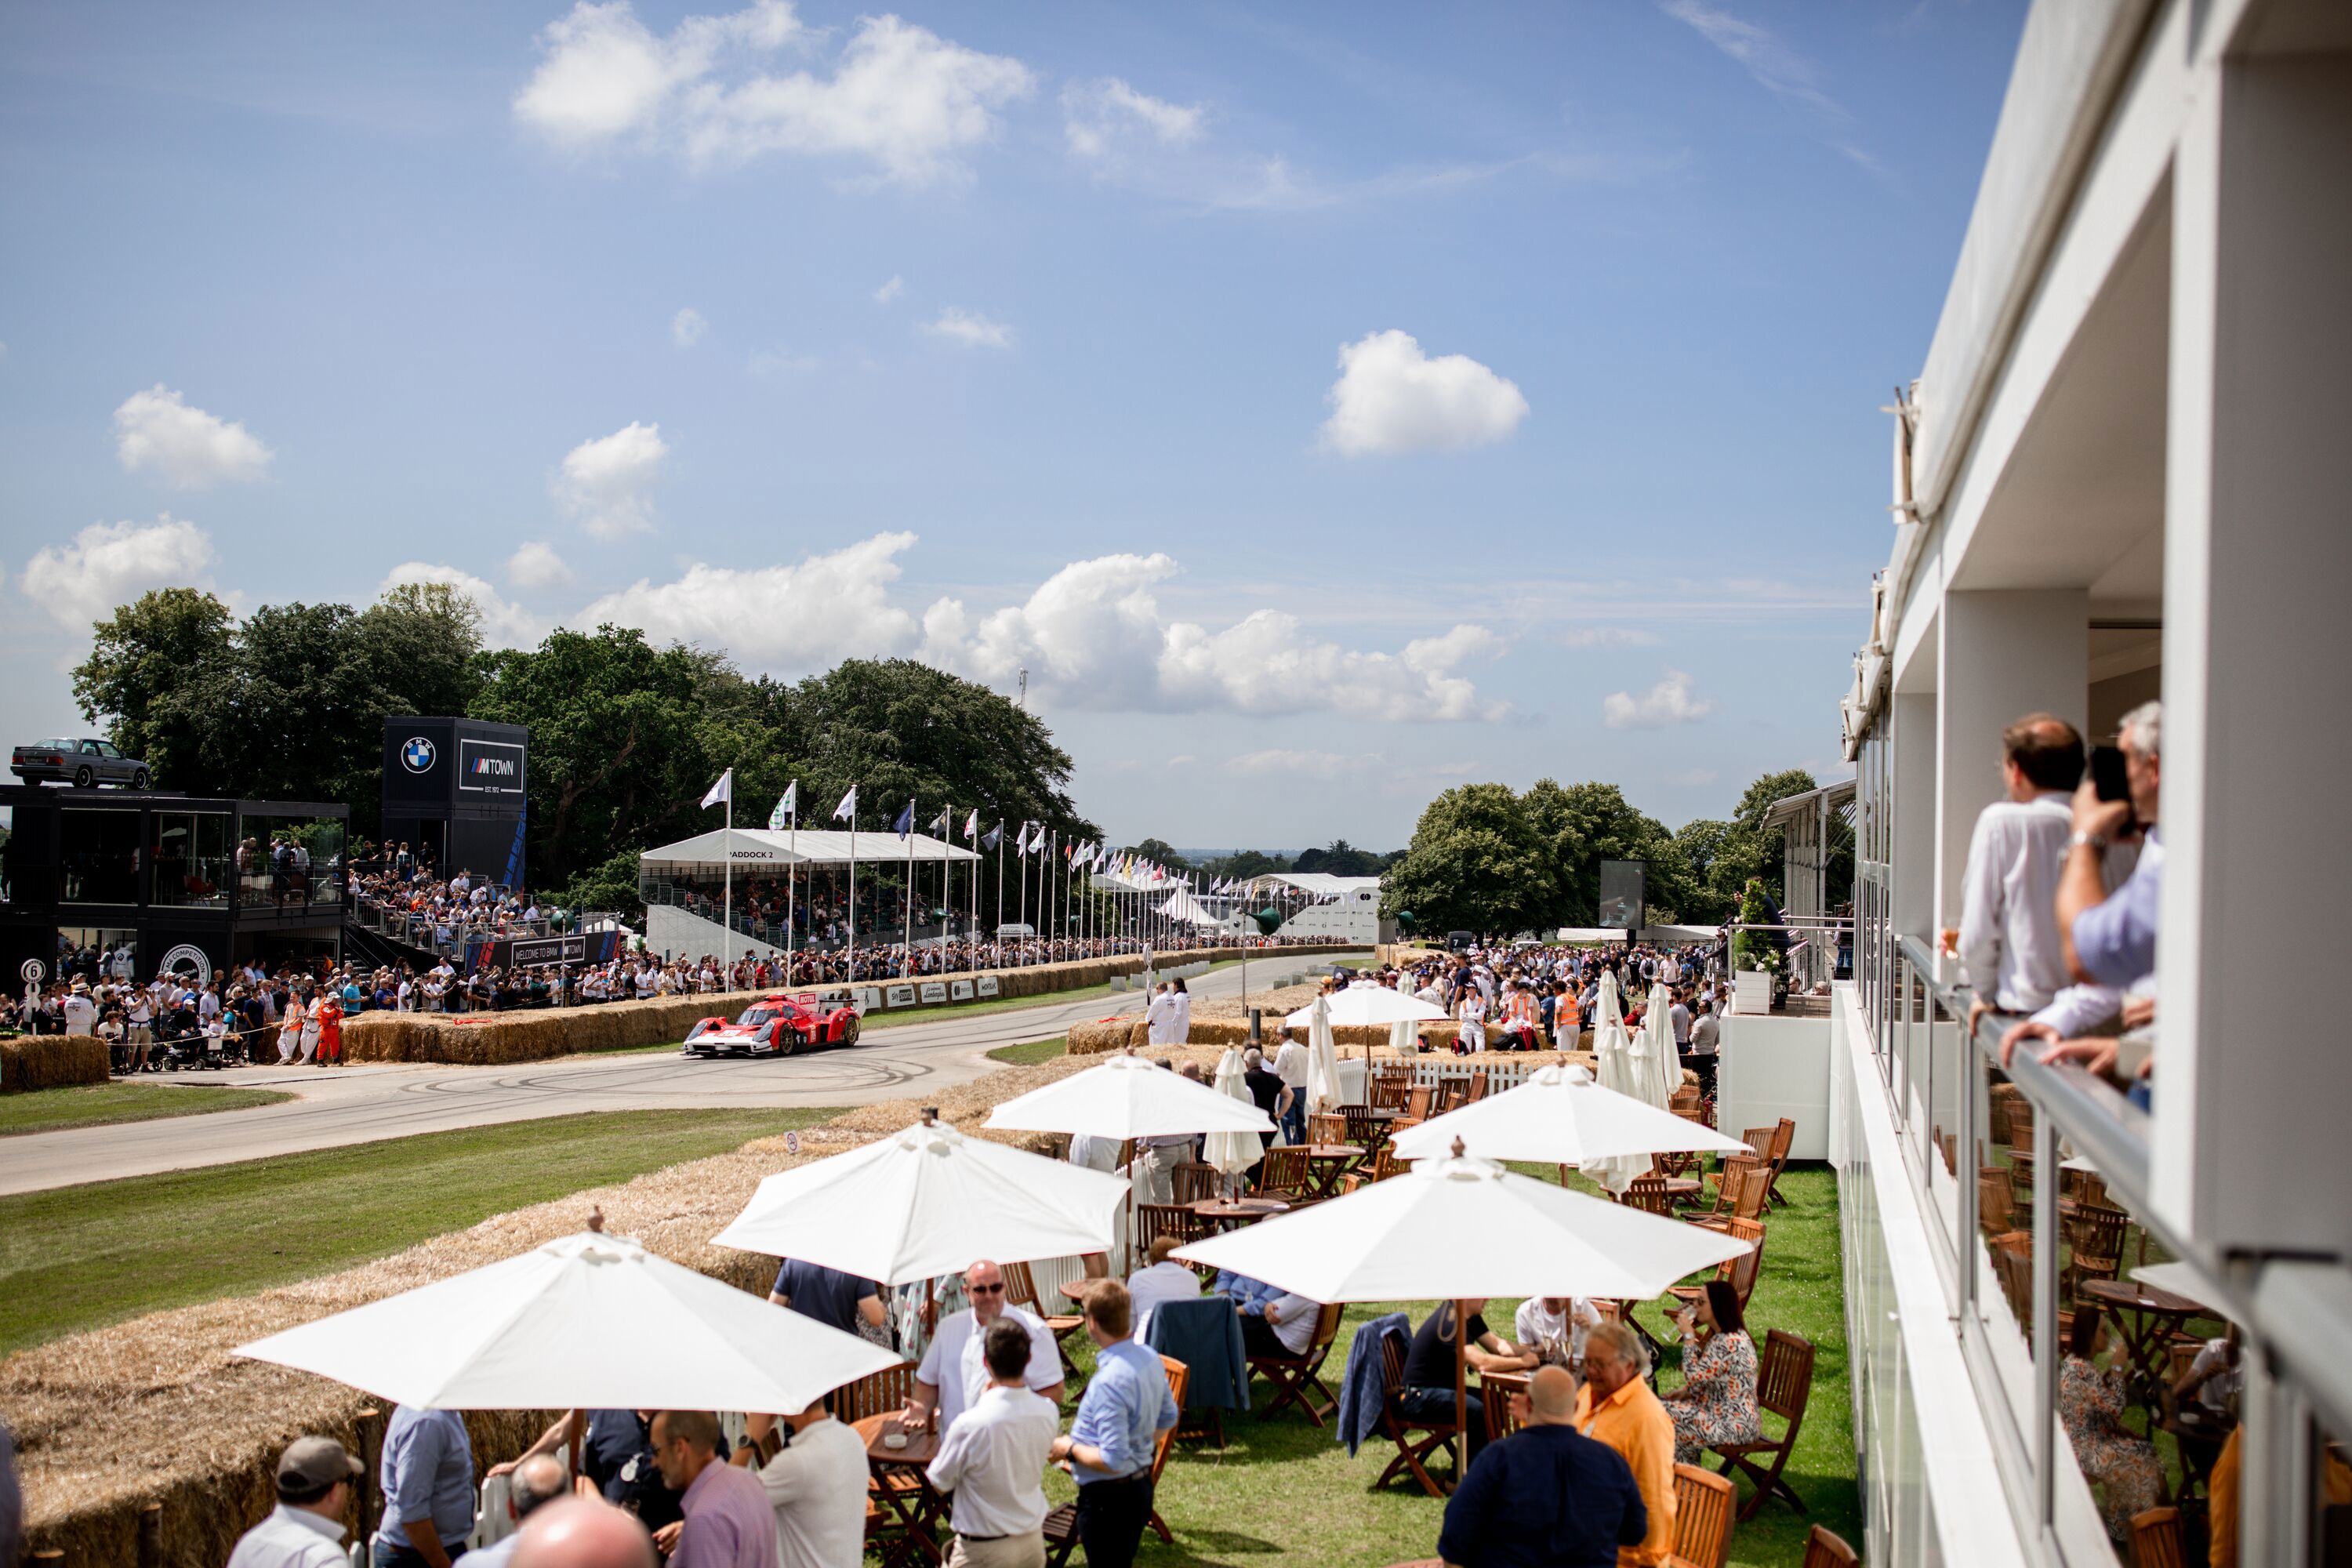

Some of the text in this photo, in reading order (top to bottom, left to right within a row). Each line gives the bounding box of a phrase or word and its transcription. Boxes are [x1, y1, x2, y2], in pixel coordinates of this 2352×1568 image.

[407, 739, 431, 750] BMW
[516, 949, 539, 960] WELCOME
[539, 948, 546, 957] TO
[546, 947, 558, 956] BMW
[165, 950, 205, 972] M4 COMPETITION
[31, 966, 37, 978] 6
[800, 995, 815, 1004] MOTUL
[899, 992, 912, 1000] sports
